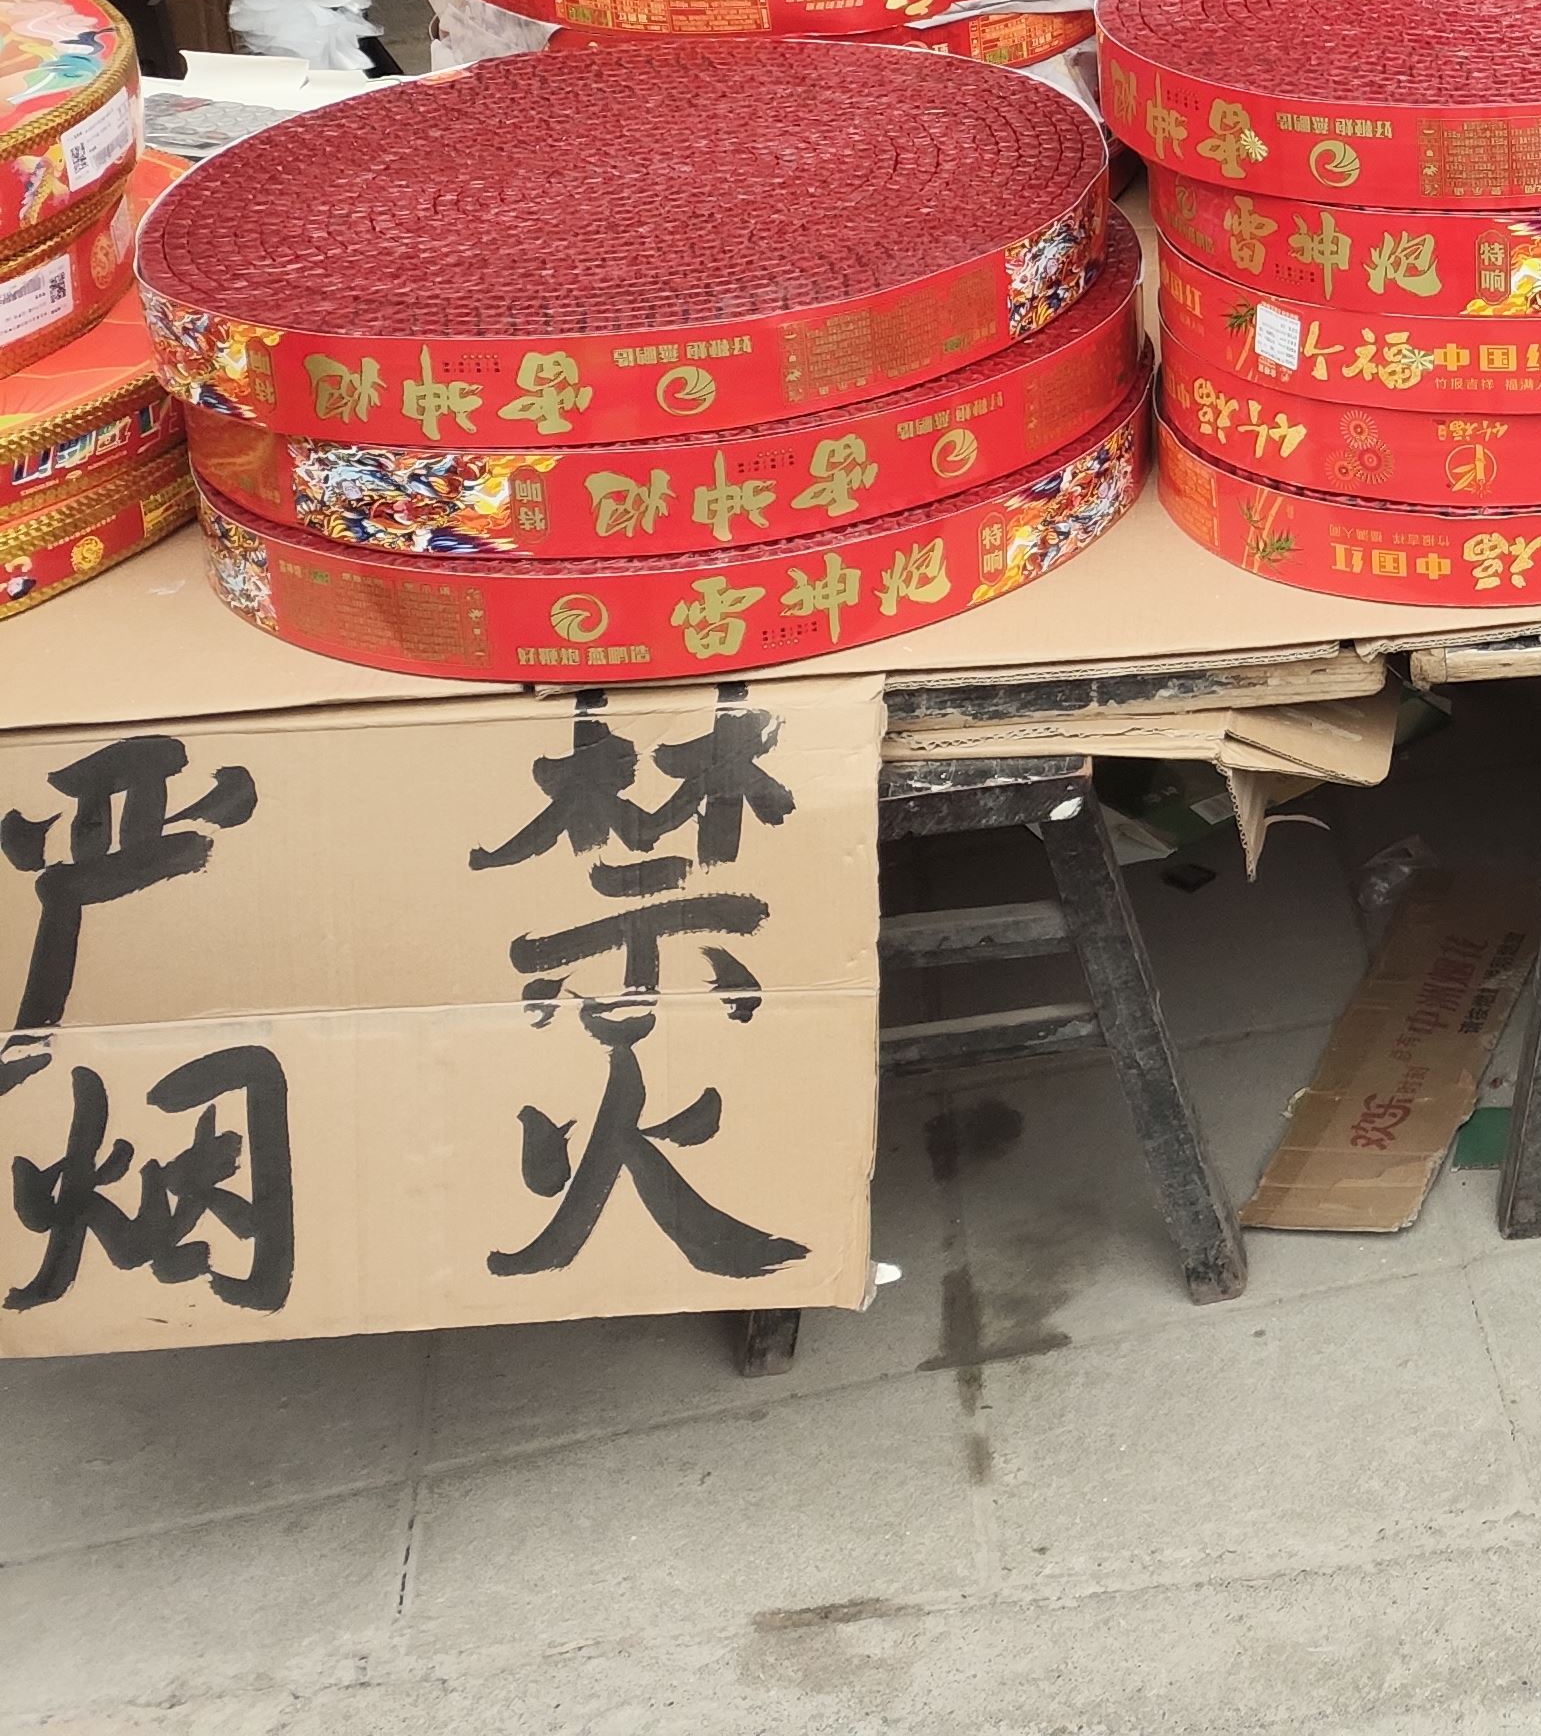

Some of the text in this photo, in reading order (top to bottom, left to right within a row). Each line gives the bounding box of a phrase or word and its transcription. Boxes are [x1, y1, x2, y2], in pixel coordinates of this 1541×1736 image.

[1223, 195, 1443, 301] 雷神炮
[1479, 240, 1505, 294] 特响
[303, 343, 592, 442] 雷神炮
[1435, 376, 1495, 392] 竹报吉祥
[584, 432, 879, 541] 雷神炮
[1328, 524, 1450, 547] 福满人间 竹报吉祥
[671, 535, 952, 659] 雷神炮
[979, 521, 1004, 573] 特响
[1329, 541, 1452, 581] 中国红
